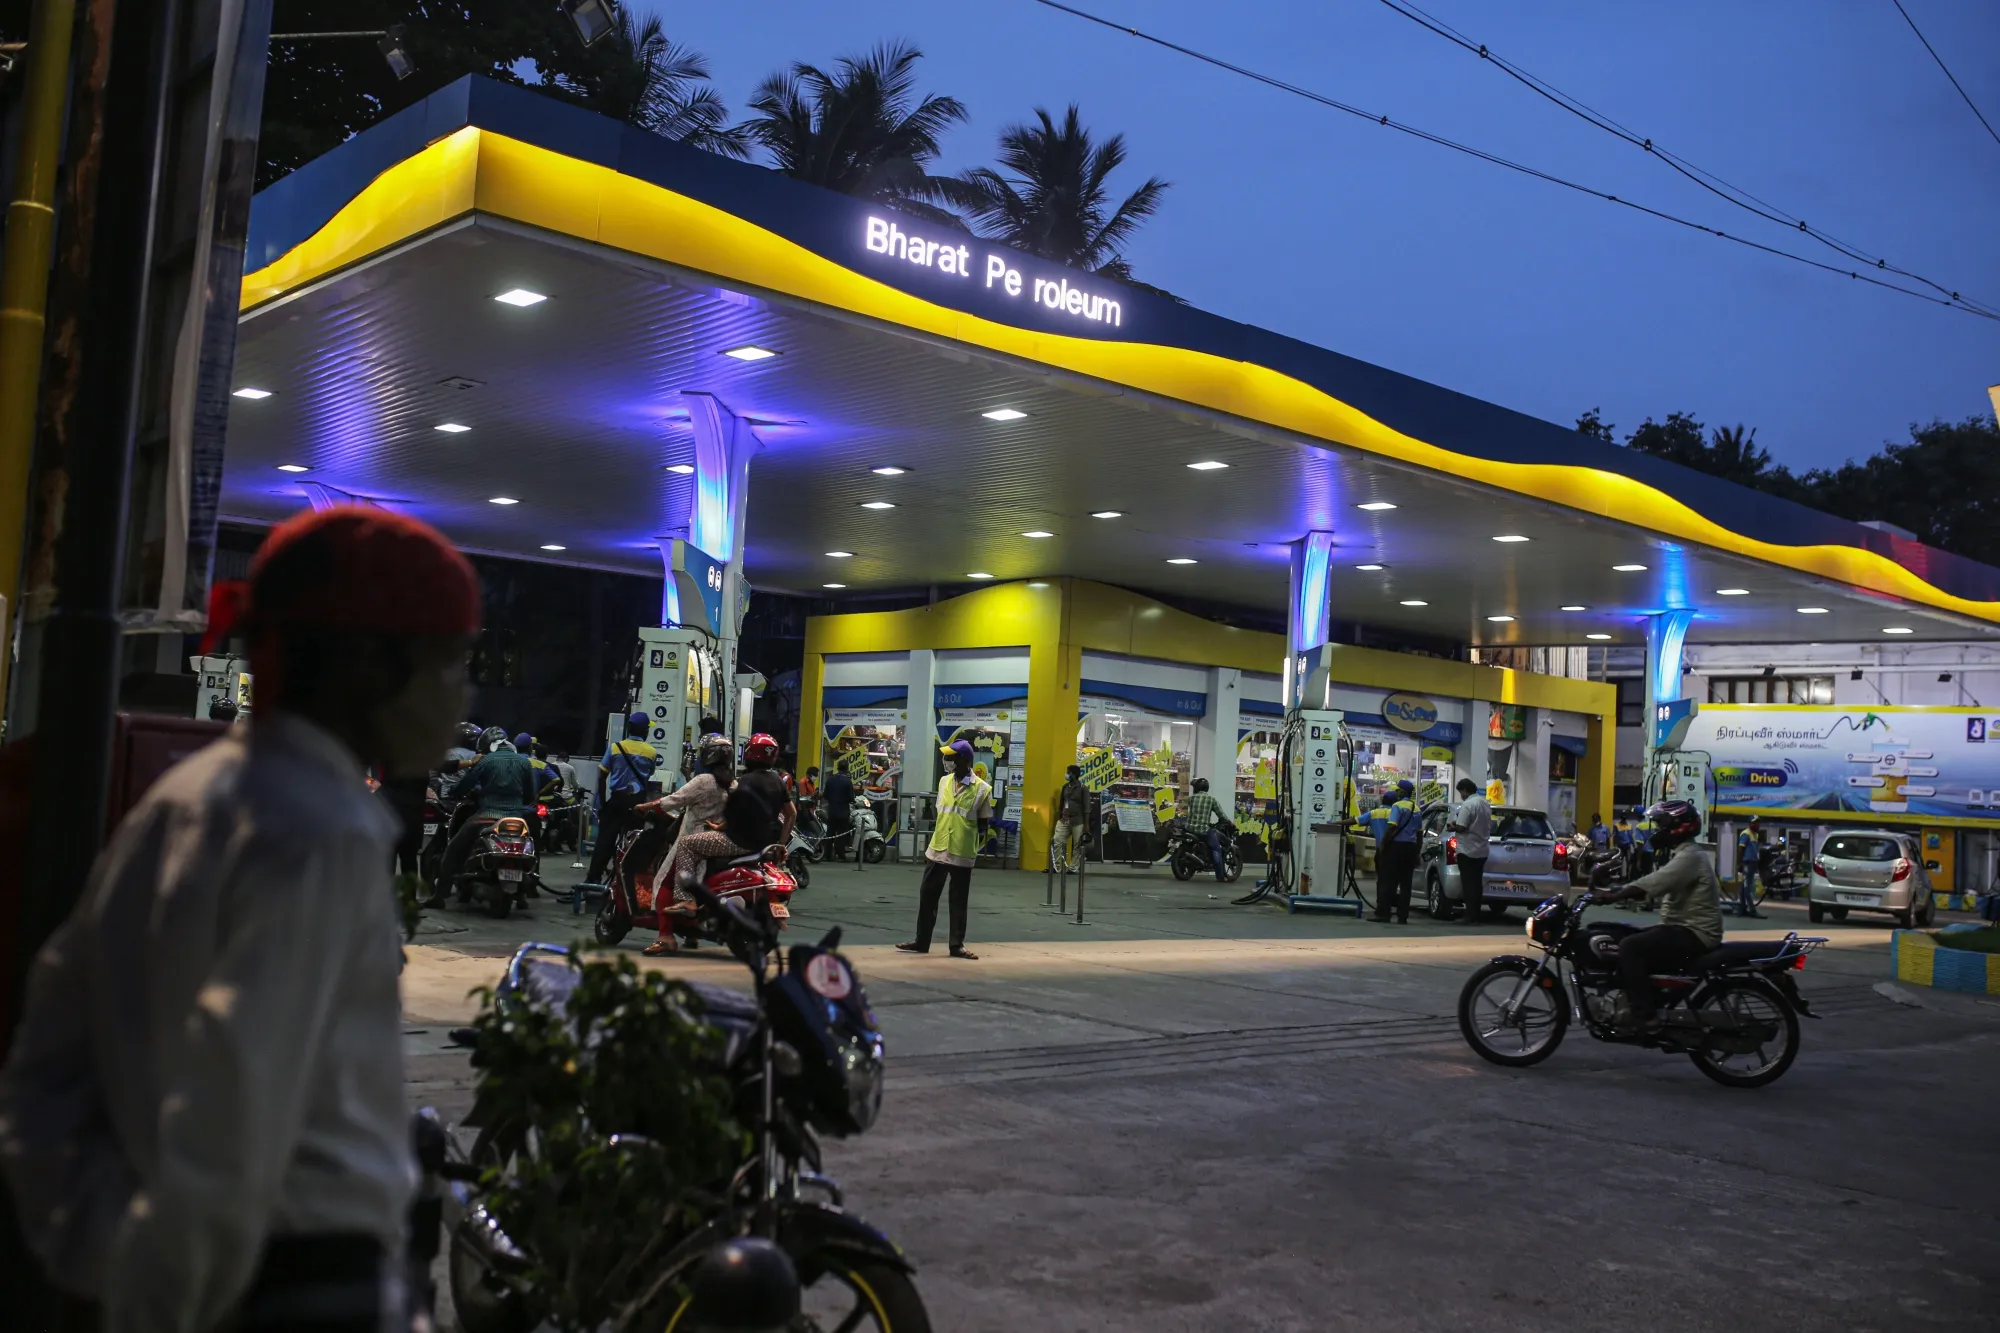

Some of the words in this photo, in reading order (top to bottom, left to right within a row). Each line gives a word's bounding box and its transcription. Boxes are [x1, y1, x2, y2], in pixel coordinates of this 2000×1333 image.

[866, 216, 969, 277] Bharat
[1080, 751, 1109, 777] SHOP
[1101, 761, 1115, 773] YOU
[1094, 768, 1121, 791] FUEL
[1750, 772, 1780, 784] Drive
